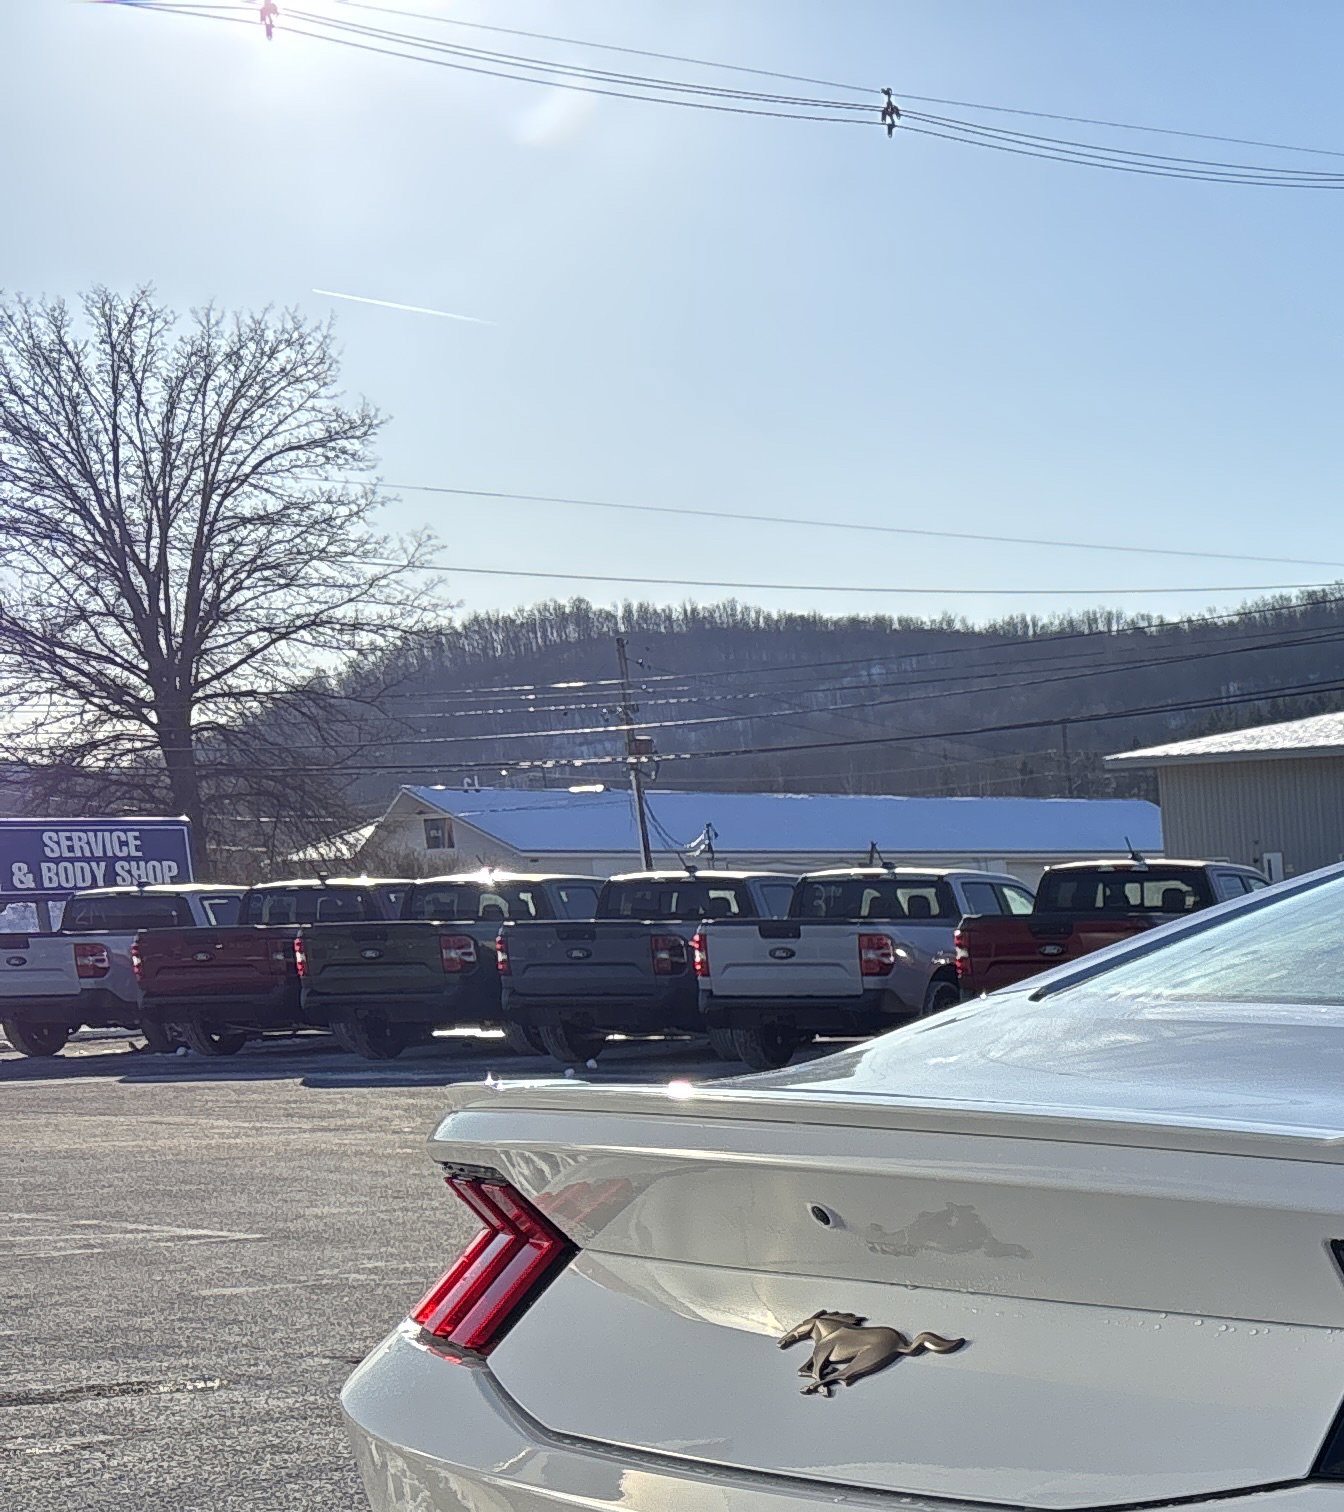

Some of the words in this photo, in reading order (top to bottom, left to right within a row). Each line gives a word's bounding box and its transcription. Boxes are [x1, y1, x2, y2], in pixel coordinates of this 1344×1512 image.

[42, 831, 143, 857] SERVICE
[11, 862, 36, 889] &
[40, 861, 106, 888] BODY
[115, 860, 178, 886] SHOP
